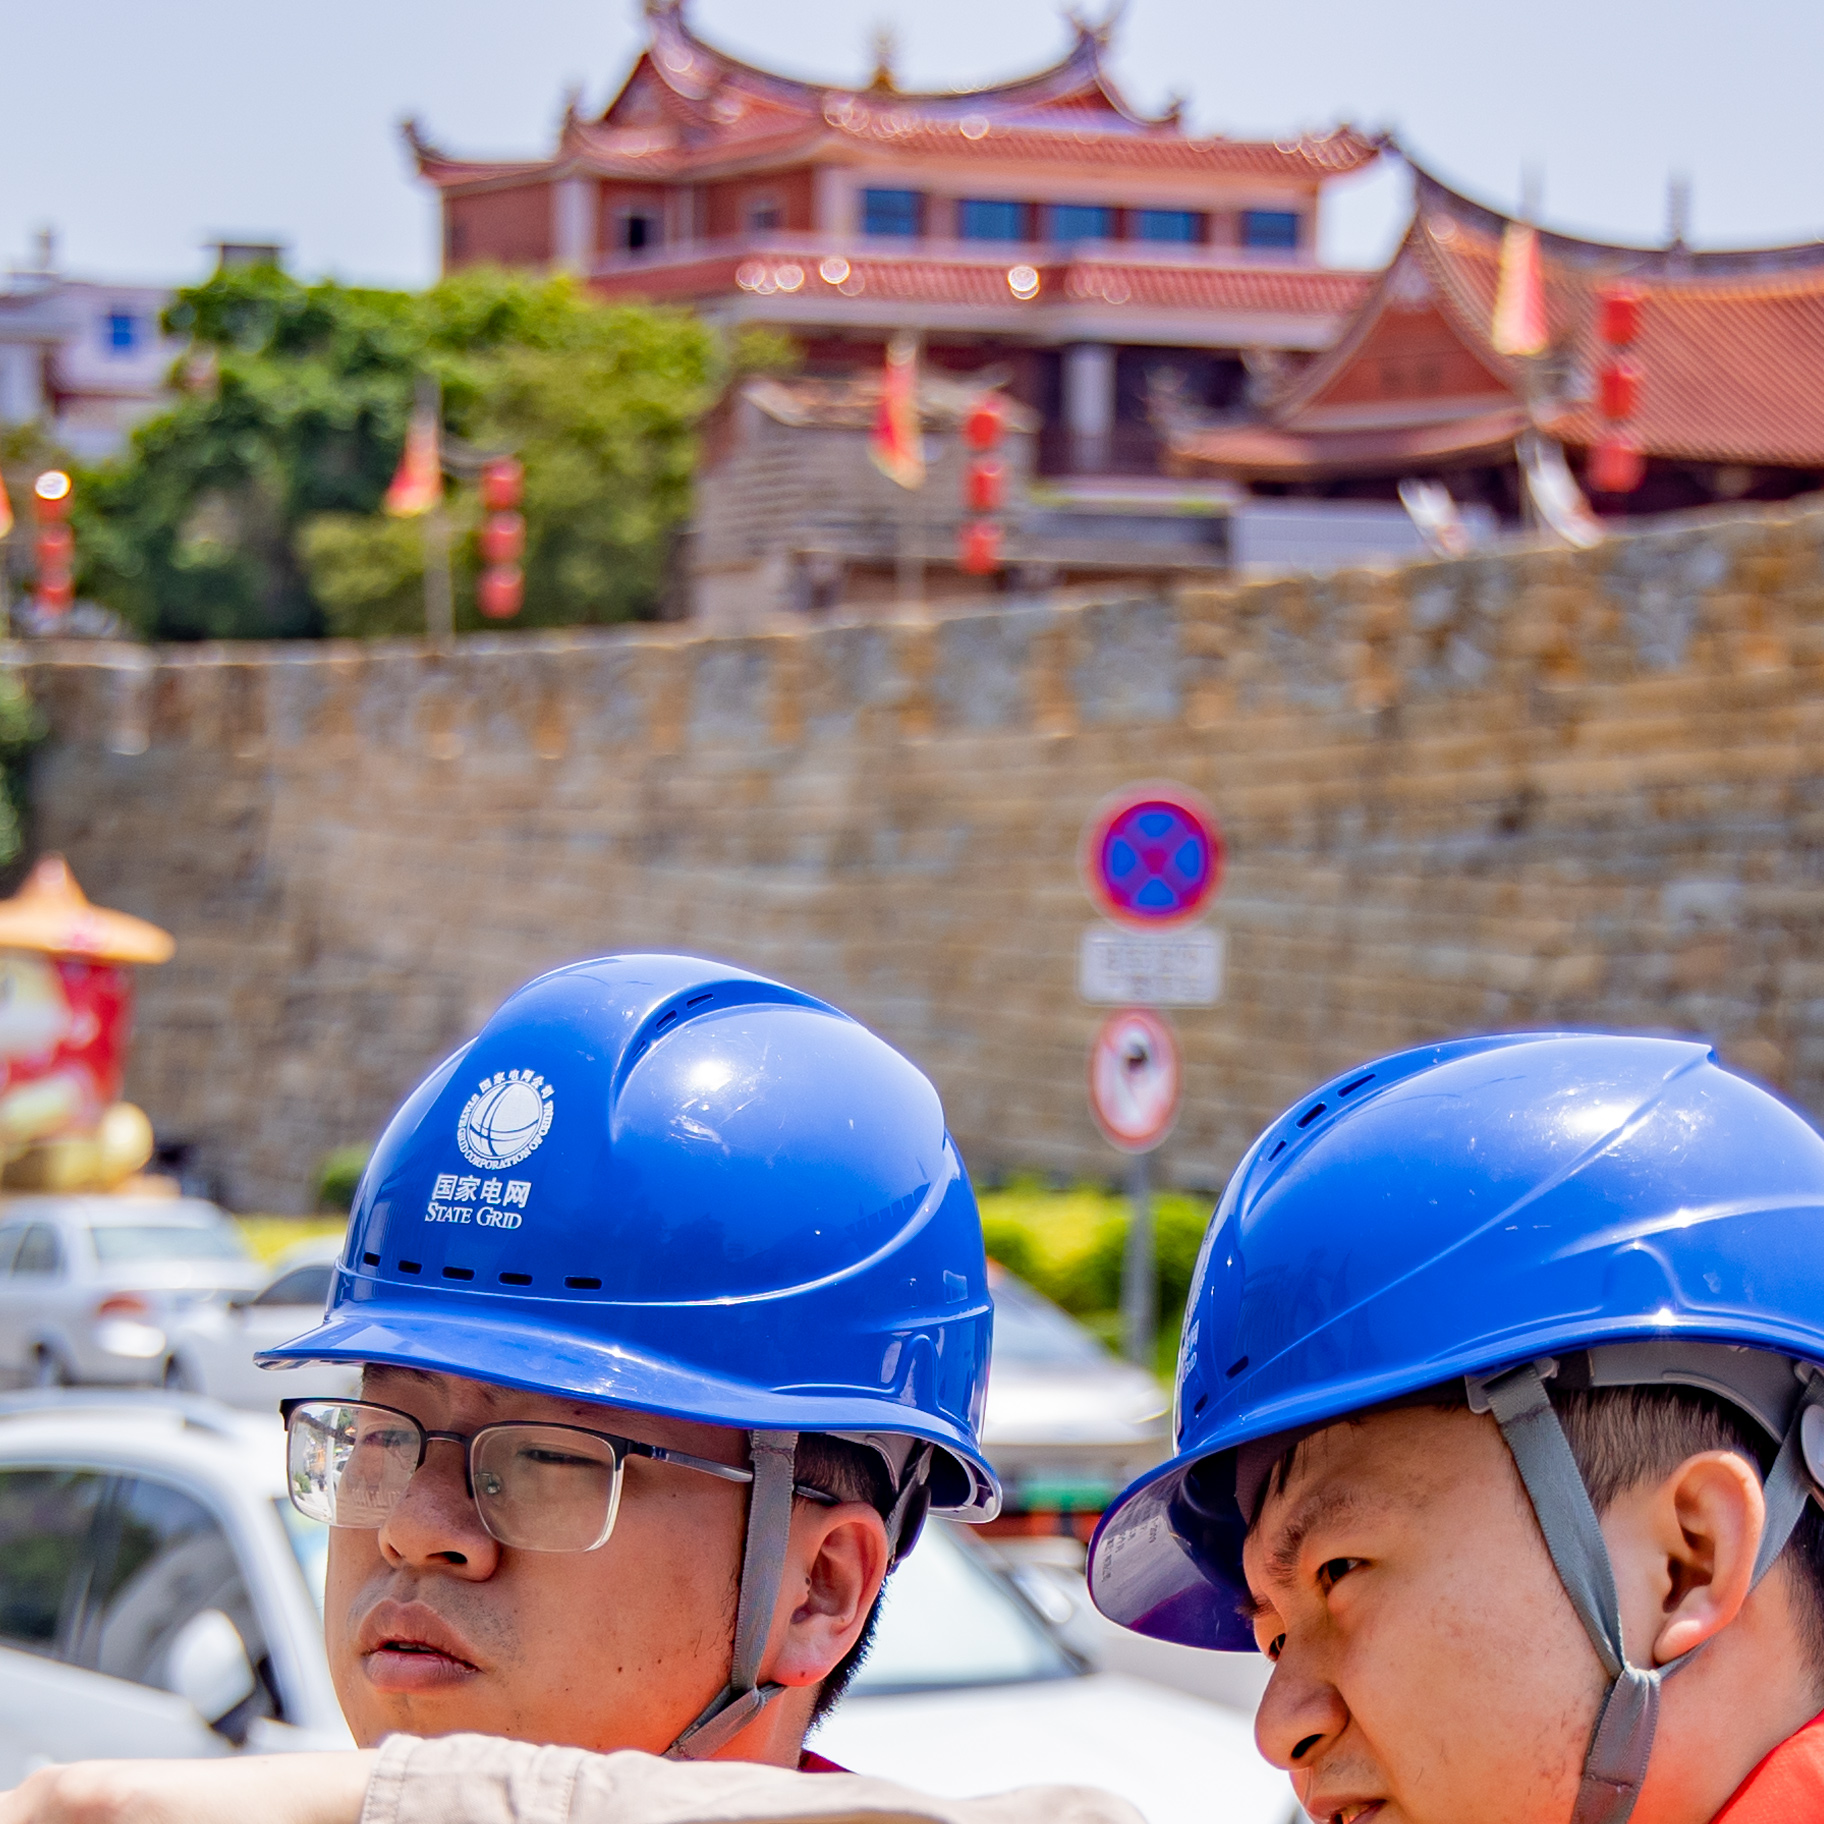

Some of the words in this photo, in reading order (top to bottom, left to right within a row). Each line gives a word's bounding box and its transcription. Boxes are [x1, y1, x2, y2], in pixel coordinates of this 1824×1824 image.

[464, 1148, 532, 1170] CORPORATION
[431, 1172, 532, 1208] 国家电网
[425, 1201, 473, 1224] STATE
[476, 1206, 523, 1229] GRID
